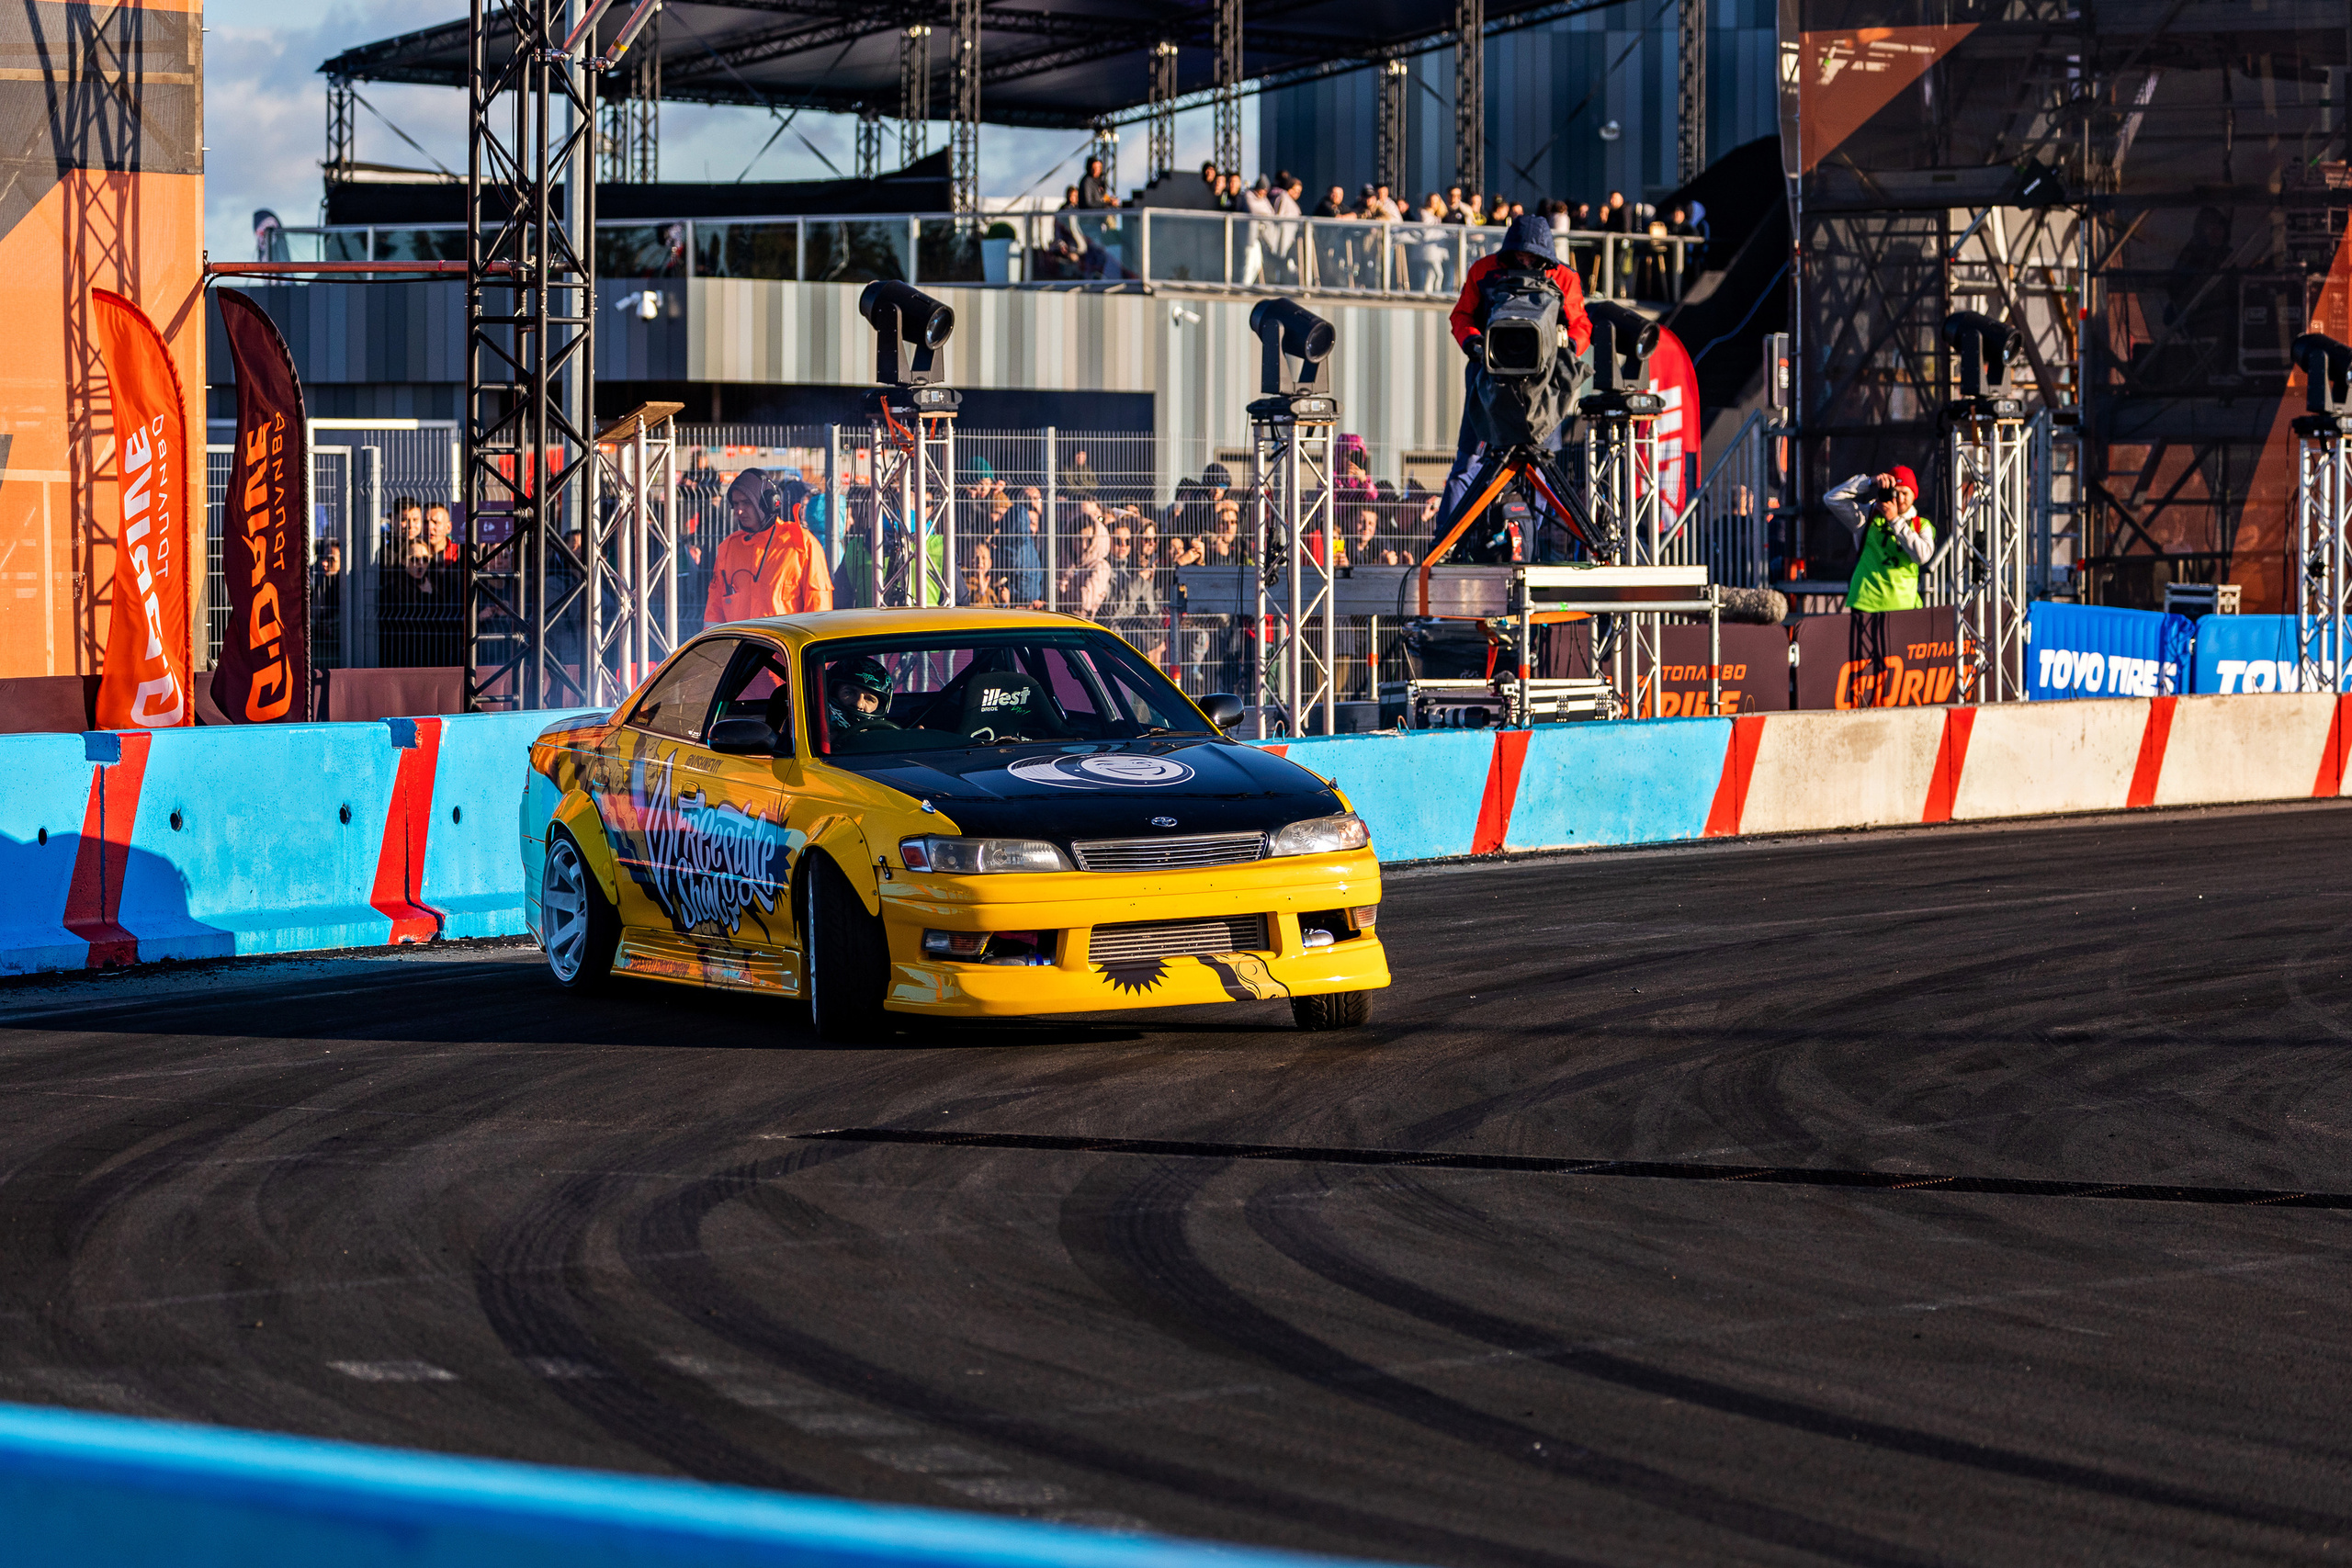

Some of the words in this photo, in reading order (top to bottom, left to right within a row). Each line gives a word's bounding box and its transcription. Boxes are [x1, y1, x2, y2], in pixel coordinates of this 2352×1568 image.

[1661, 664, 1747, 682] ТОПЛВО
[2039, 649, 2105, 693] TOYO
[2109, 655, 2177, 697] TIRES
[981, 686, 1031, 706] illest
